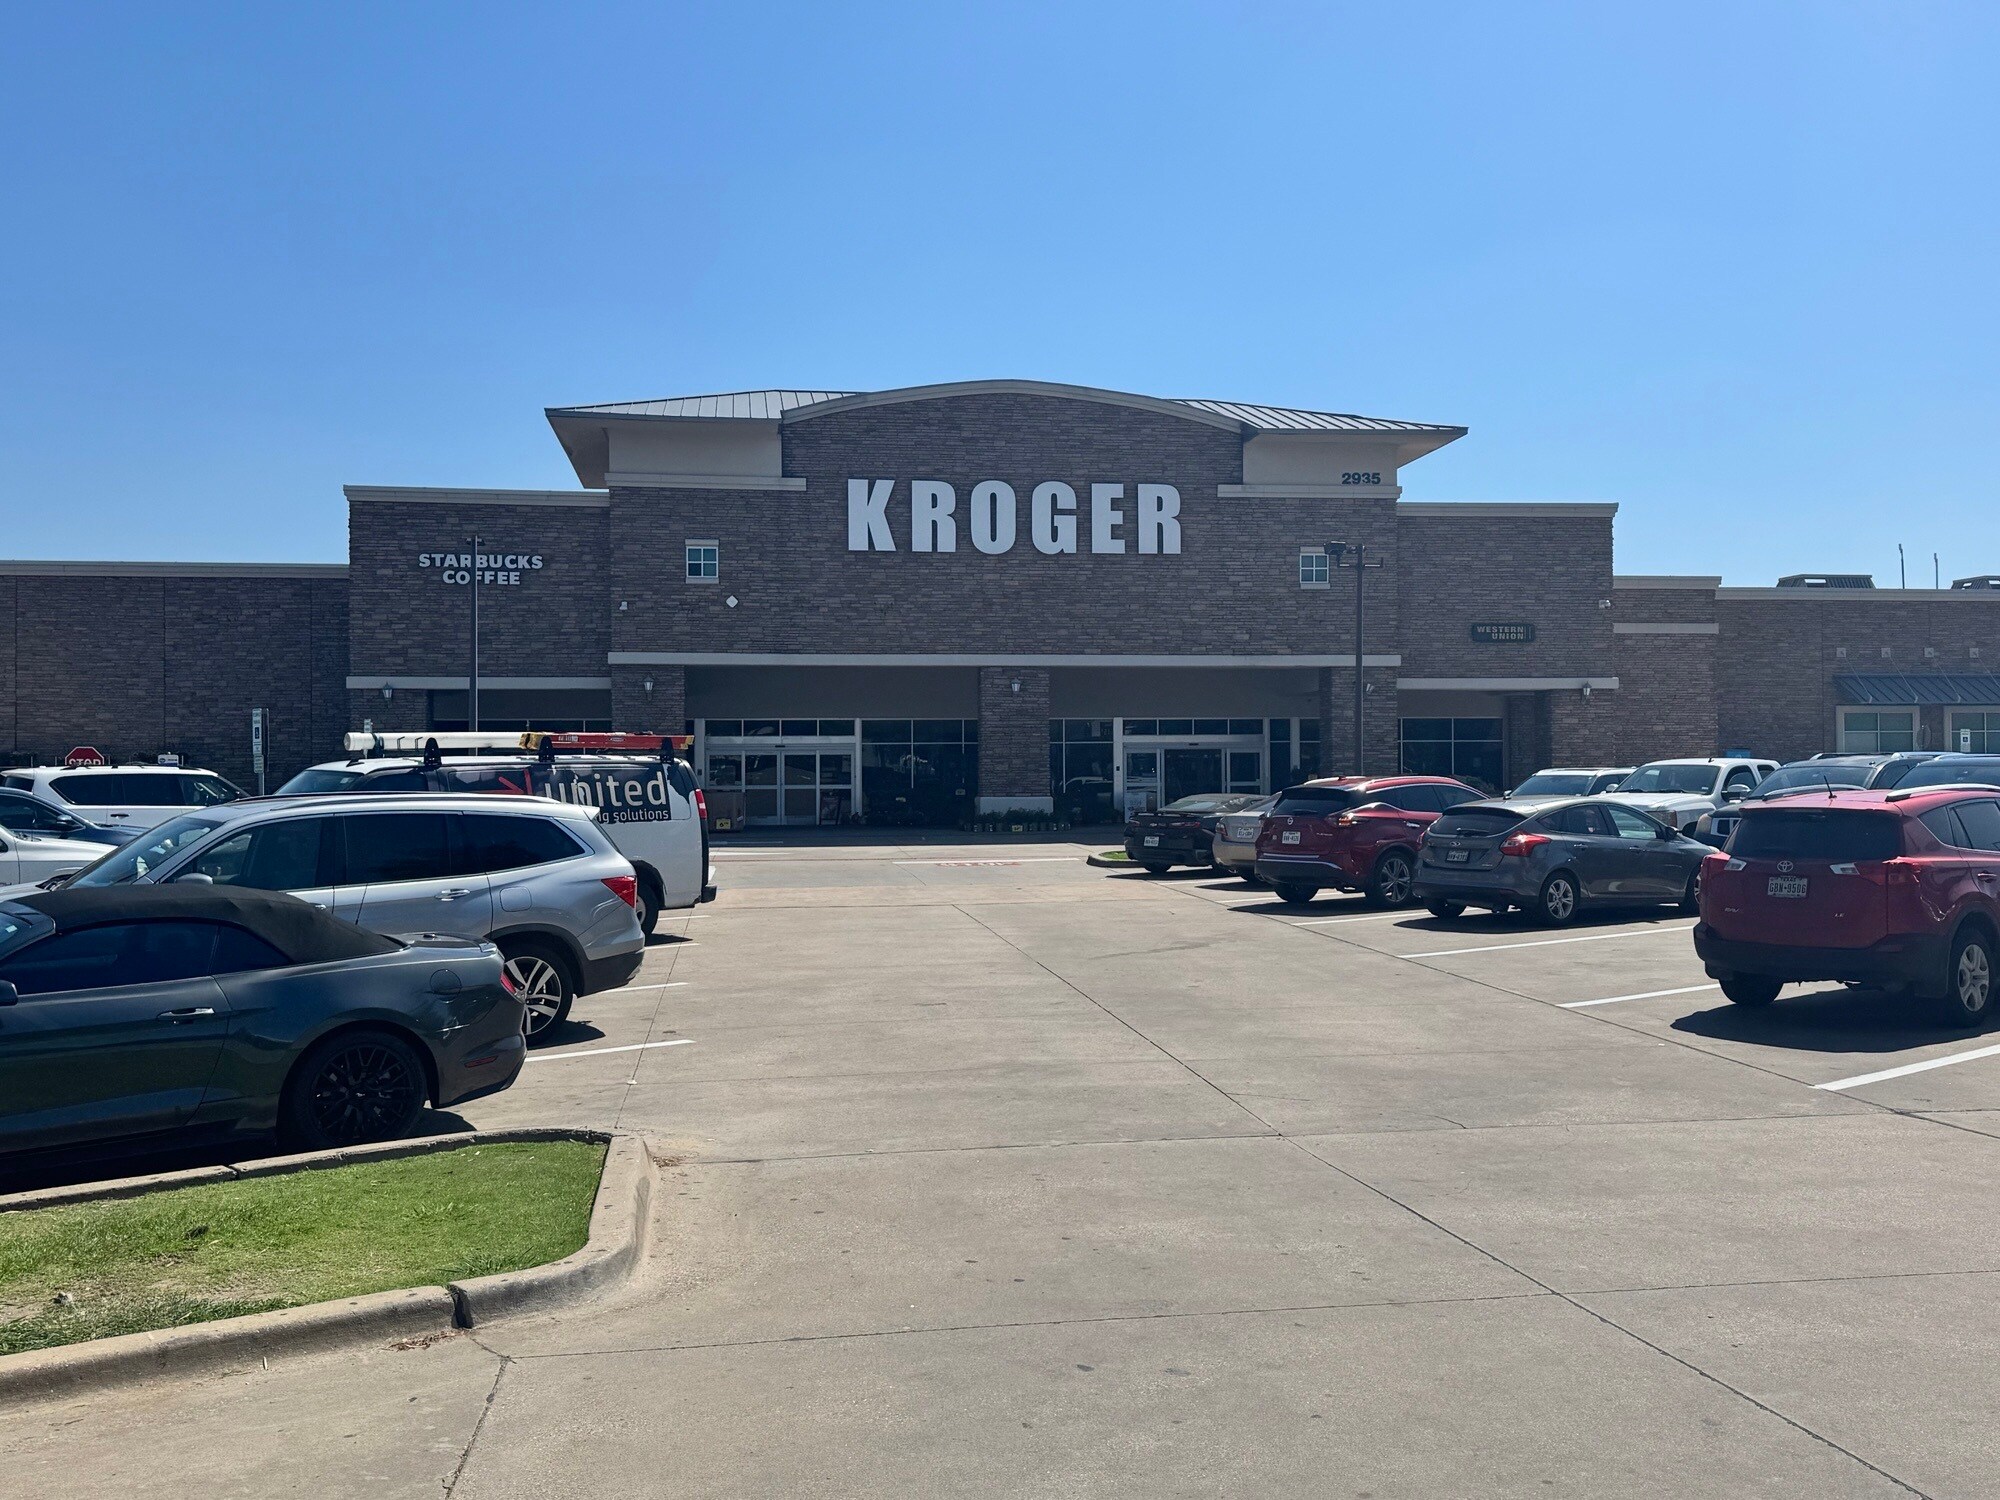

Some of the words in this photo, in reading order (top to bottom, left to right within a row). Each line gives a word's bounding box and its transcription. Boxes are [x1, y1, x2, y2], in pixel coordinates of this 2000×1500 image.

[1341, 472, 1381, 485] 2935
[848, 479, 1182, 555] KROGER
[418, 553, 543, 569] STARBUCKS
[544, 771, 667, 807] united
[613, 808, 669, 821] solutions
